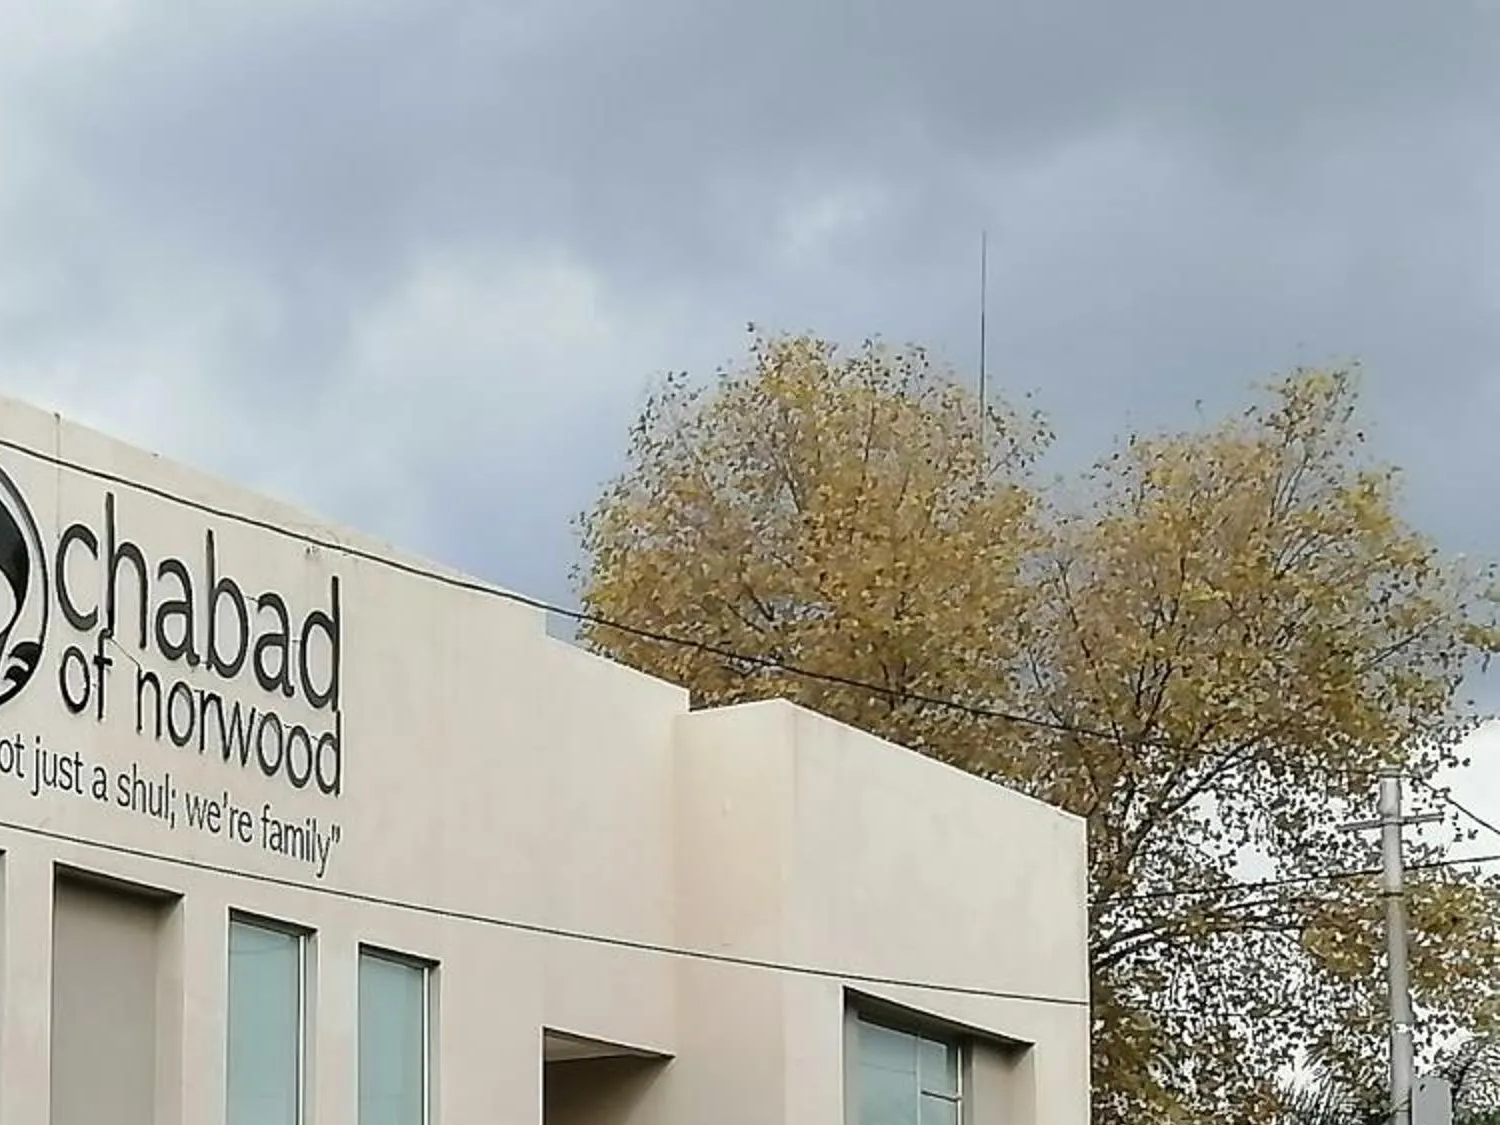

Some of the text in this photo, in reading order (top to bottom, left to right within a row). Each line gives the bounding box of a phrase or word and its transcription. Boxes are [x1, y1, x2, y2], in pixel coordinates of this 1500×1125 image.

[55, 490, 341, 713] chabad
[30, 735, 84, 797] just
[91, 766, 109, 802] a
[116, 762, 177, 830] shul;
[59, 628, 343, 797] of norwood
